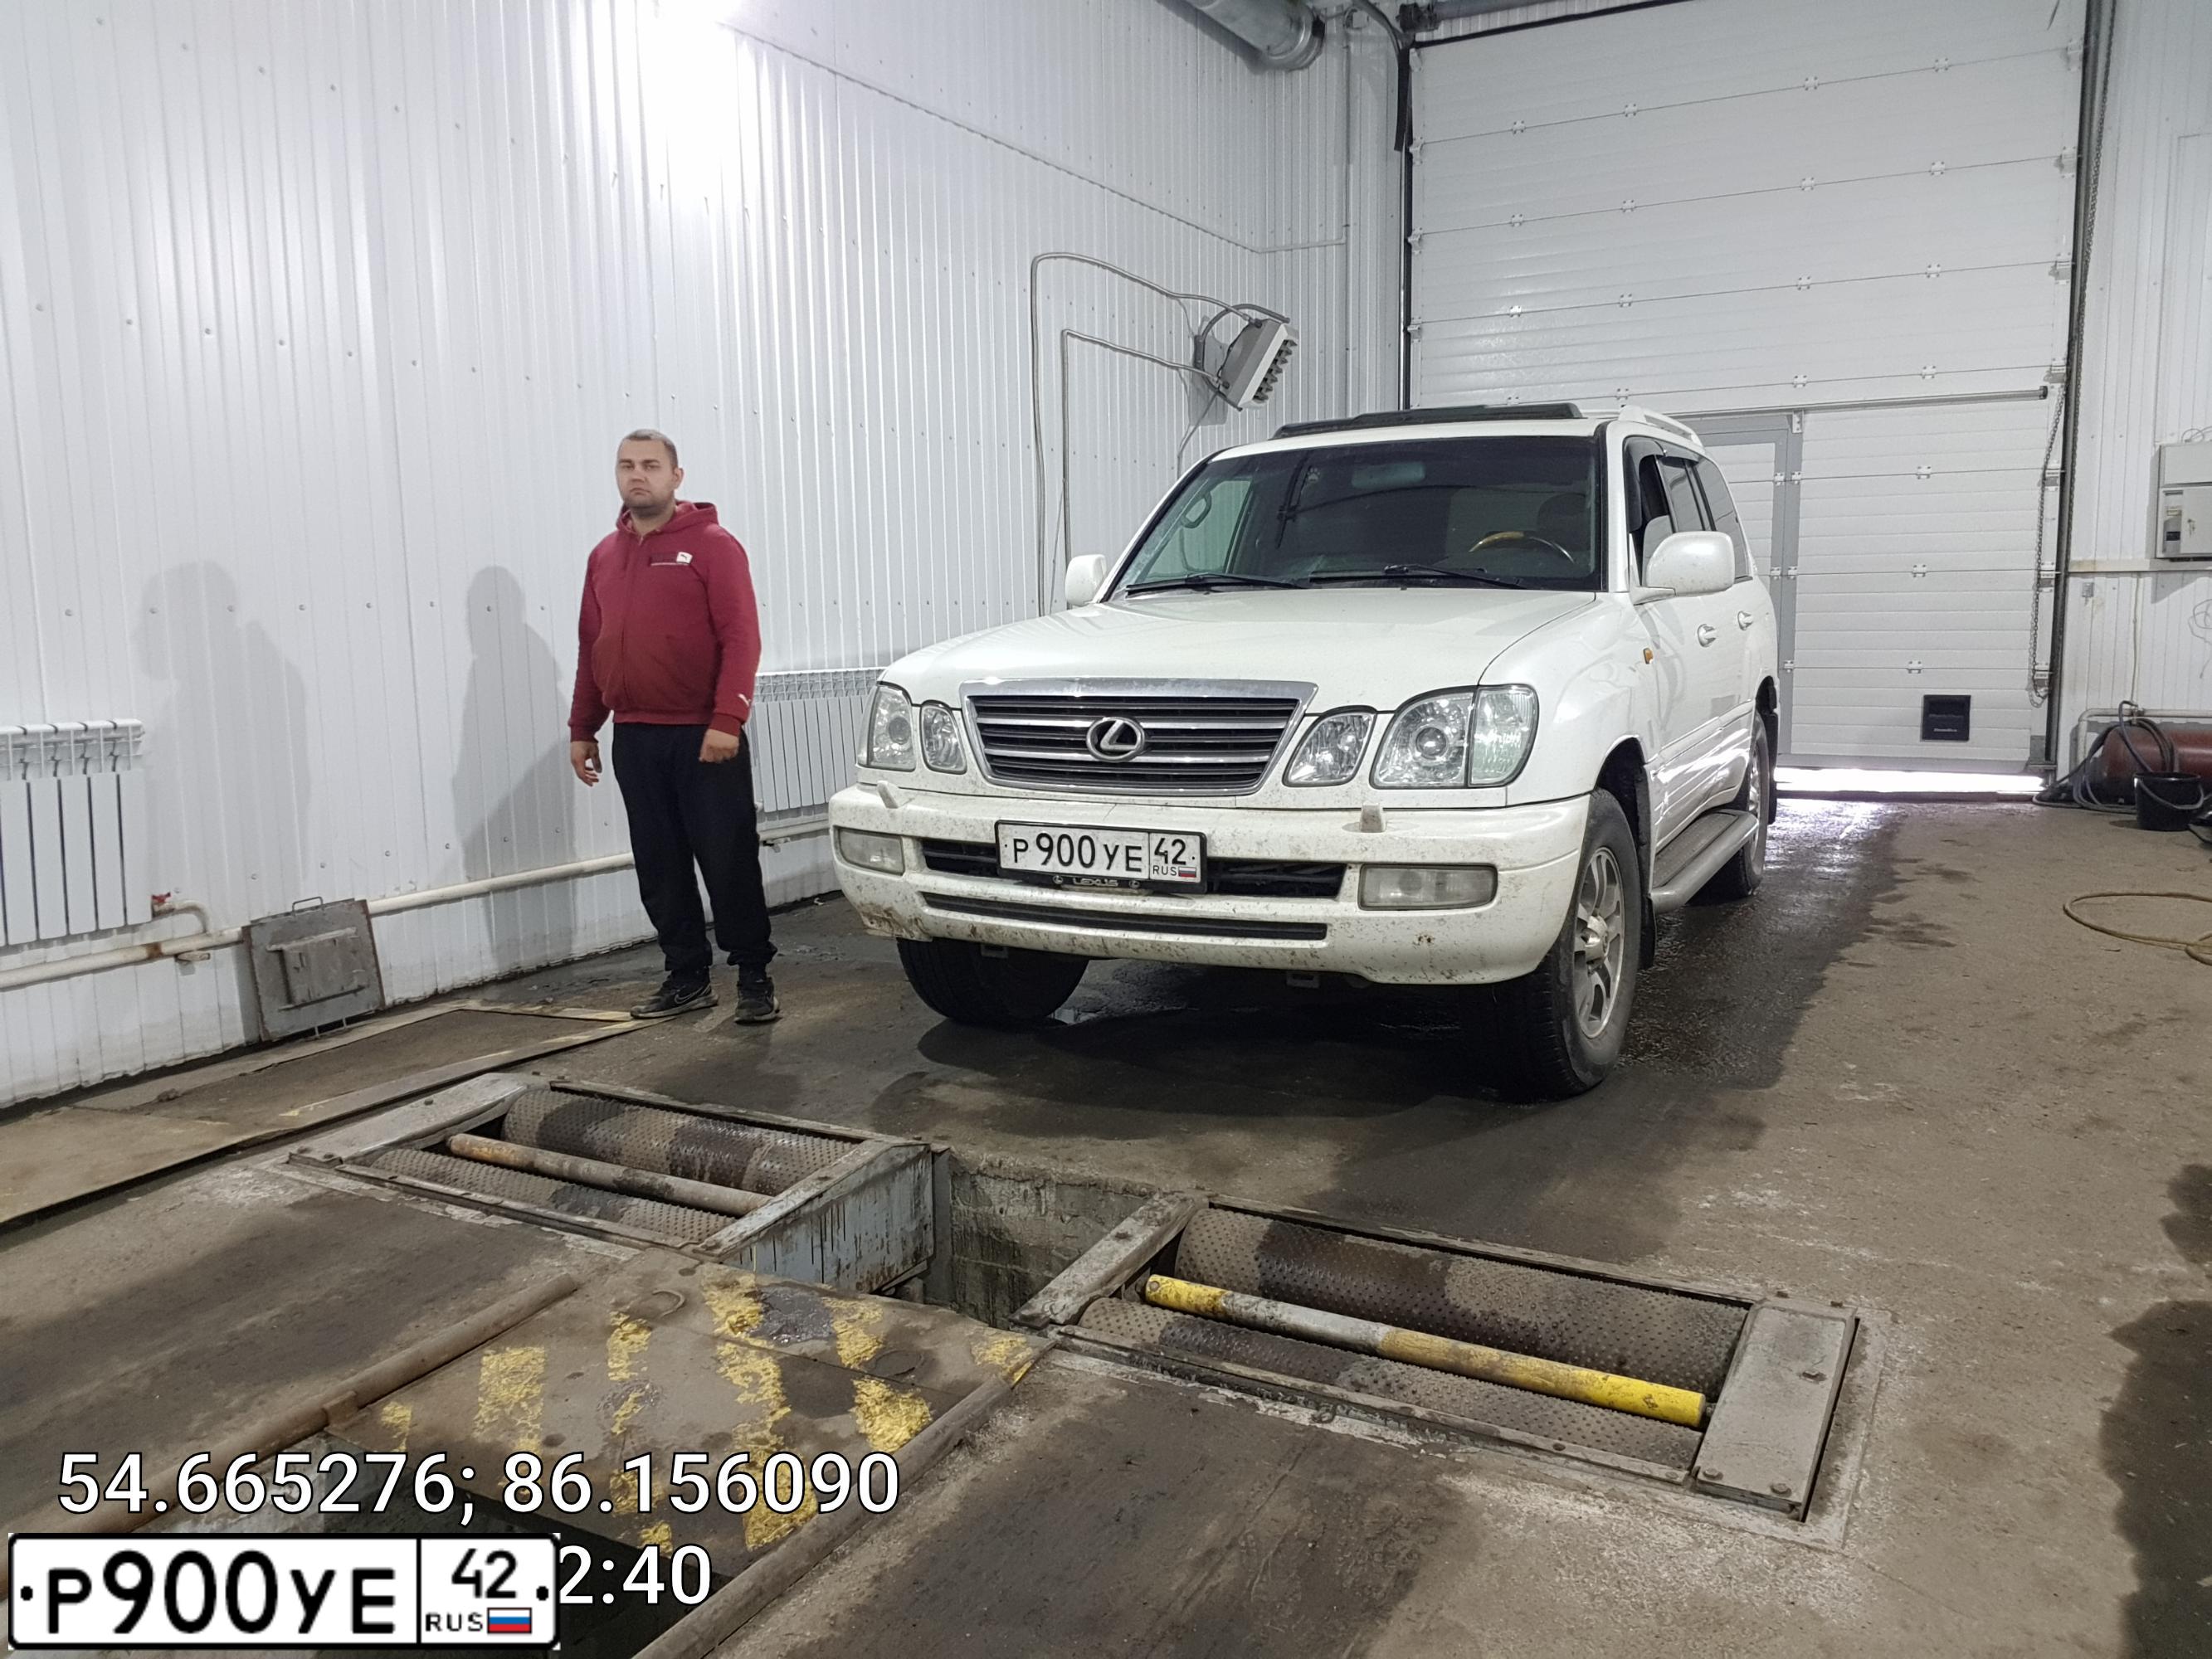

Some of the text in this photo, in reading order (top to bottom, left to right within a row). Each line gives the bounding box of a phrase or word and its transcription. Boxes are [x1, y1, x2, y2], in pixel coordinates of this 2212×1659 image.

[1013, 832, 1143, 873] Р900УЕ
[1153, 837, 1186, 865] 42
[1152, 865, 1177, 876] RUS
[1073, 877, 1118, 887] LEXUS
